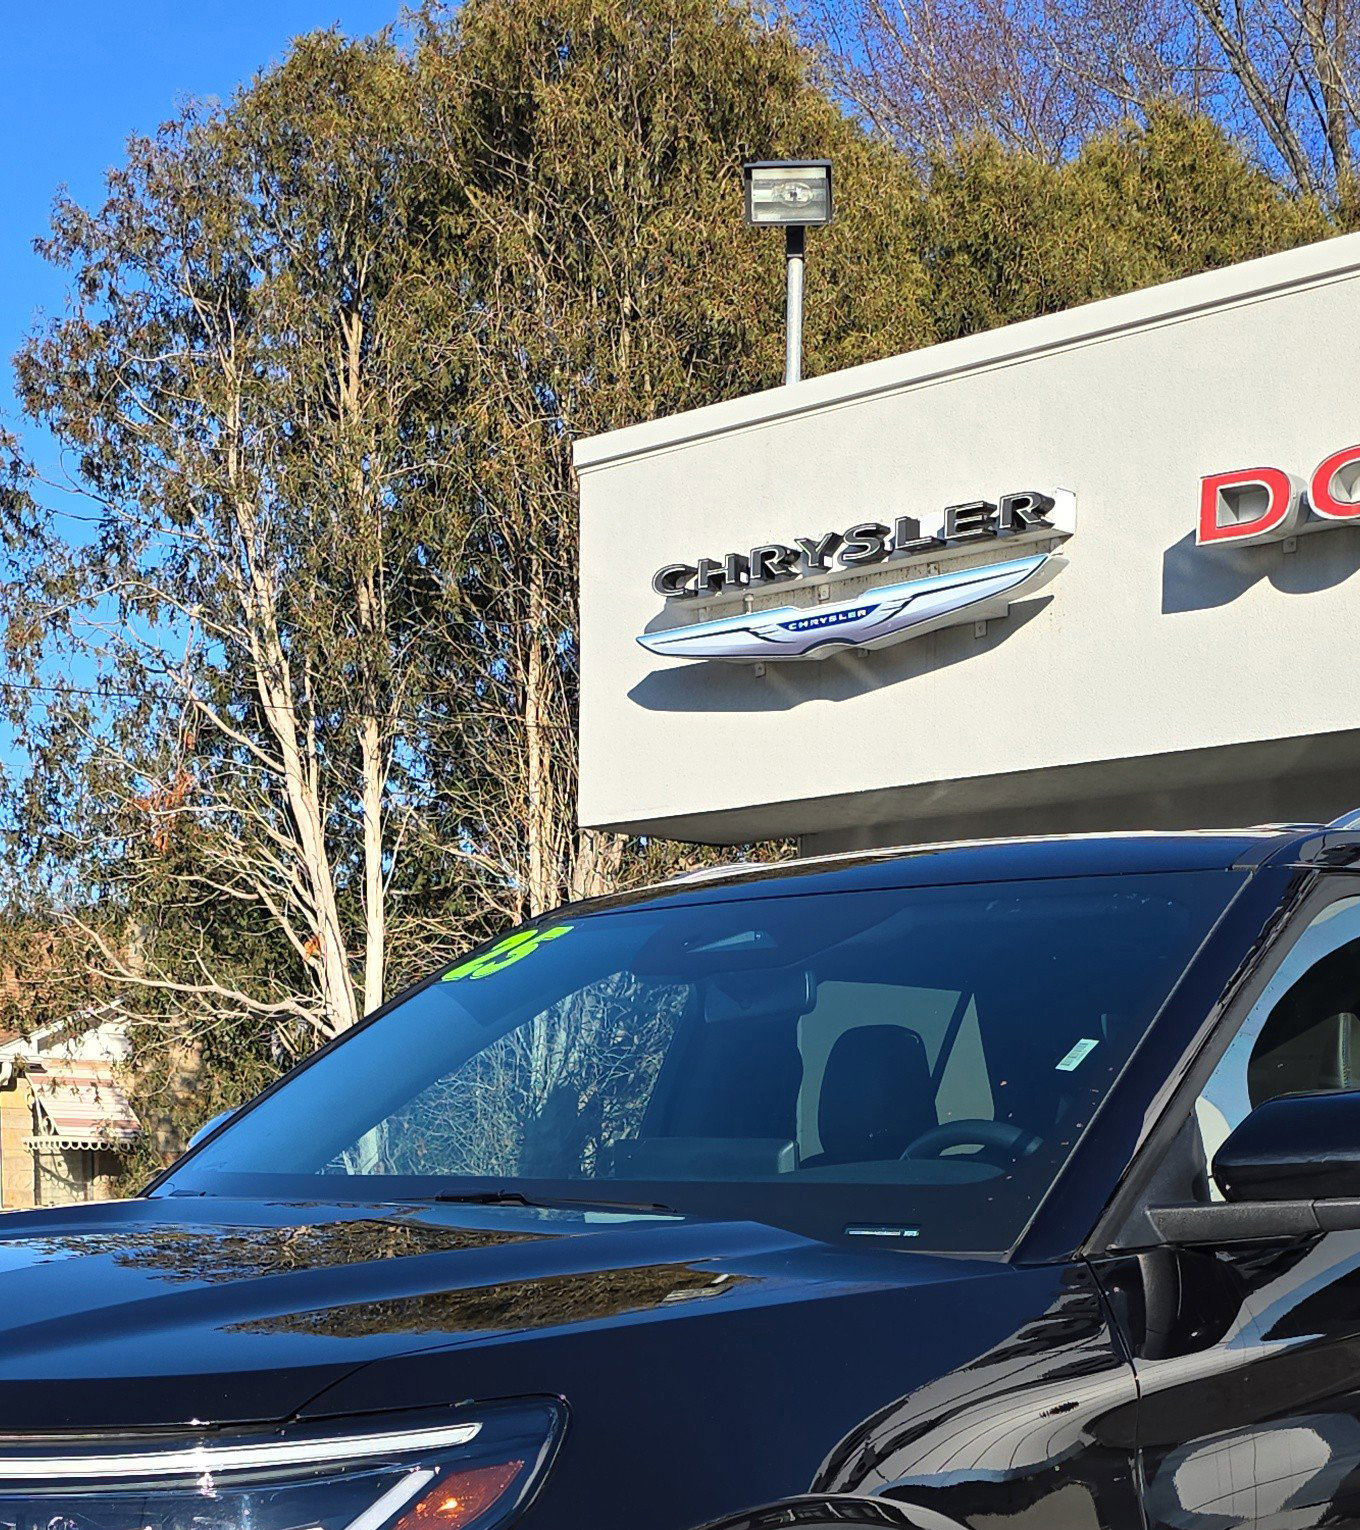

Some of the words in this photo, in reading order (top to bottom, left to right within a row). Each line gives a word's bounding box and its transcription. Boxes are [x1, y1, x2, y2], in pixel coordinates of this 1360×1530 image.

[652, 490, 1056, 599] CHRYSLER
[788, 609, 867, 630] CHRYSLER
[441, 926, 574, 982] 25
